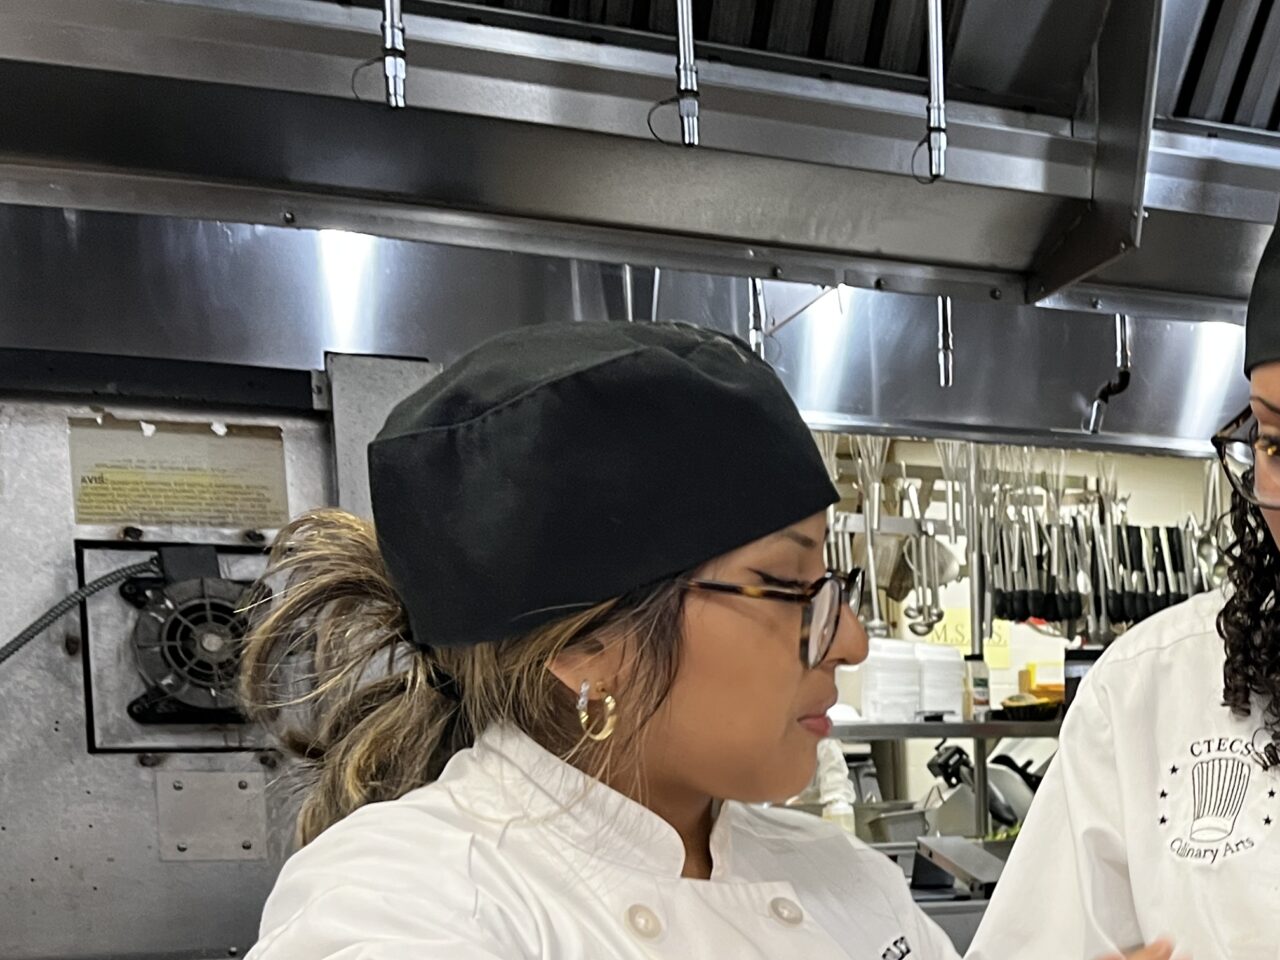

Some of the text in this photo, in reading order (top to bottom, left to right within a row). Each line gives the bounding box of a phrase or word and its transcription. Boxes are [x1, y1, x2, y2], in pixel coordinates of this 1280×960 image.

[1190, 738, 1252, 757] CTECS
[1170, 838, 1254, 864] Culinary Arts
